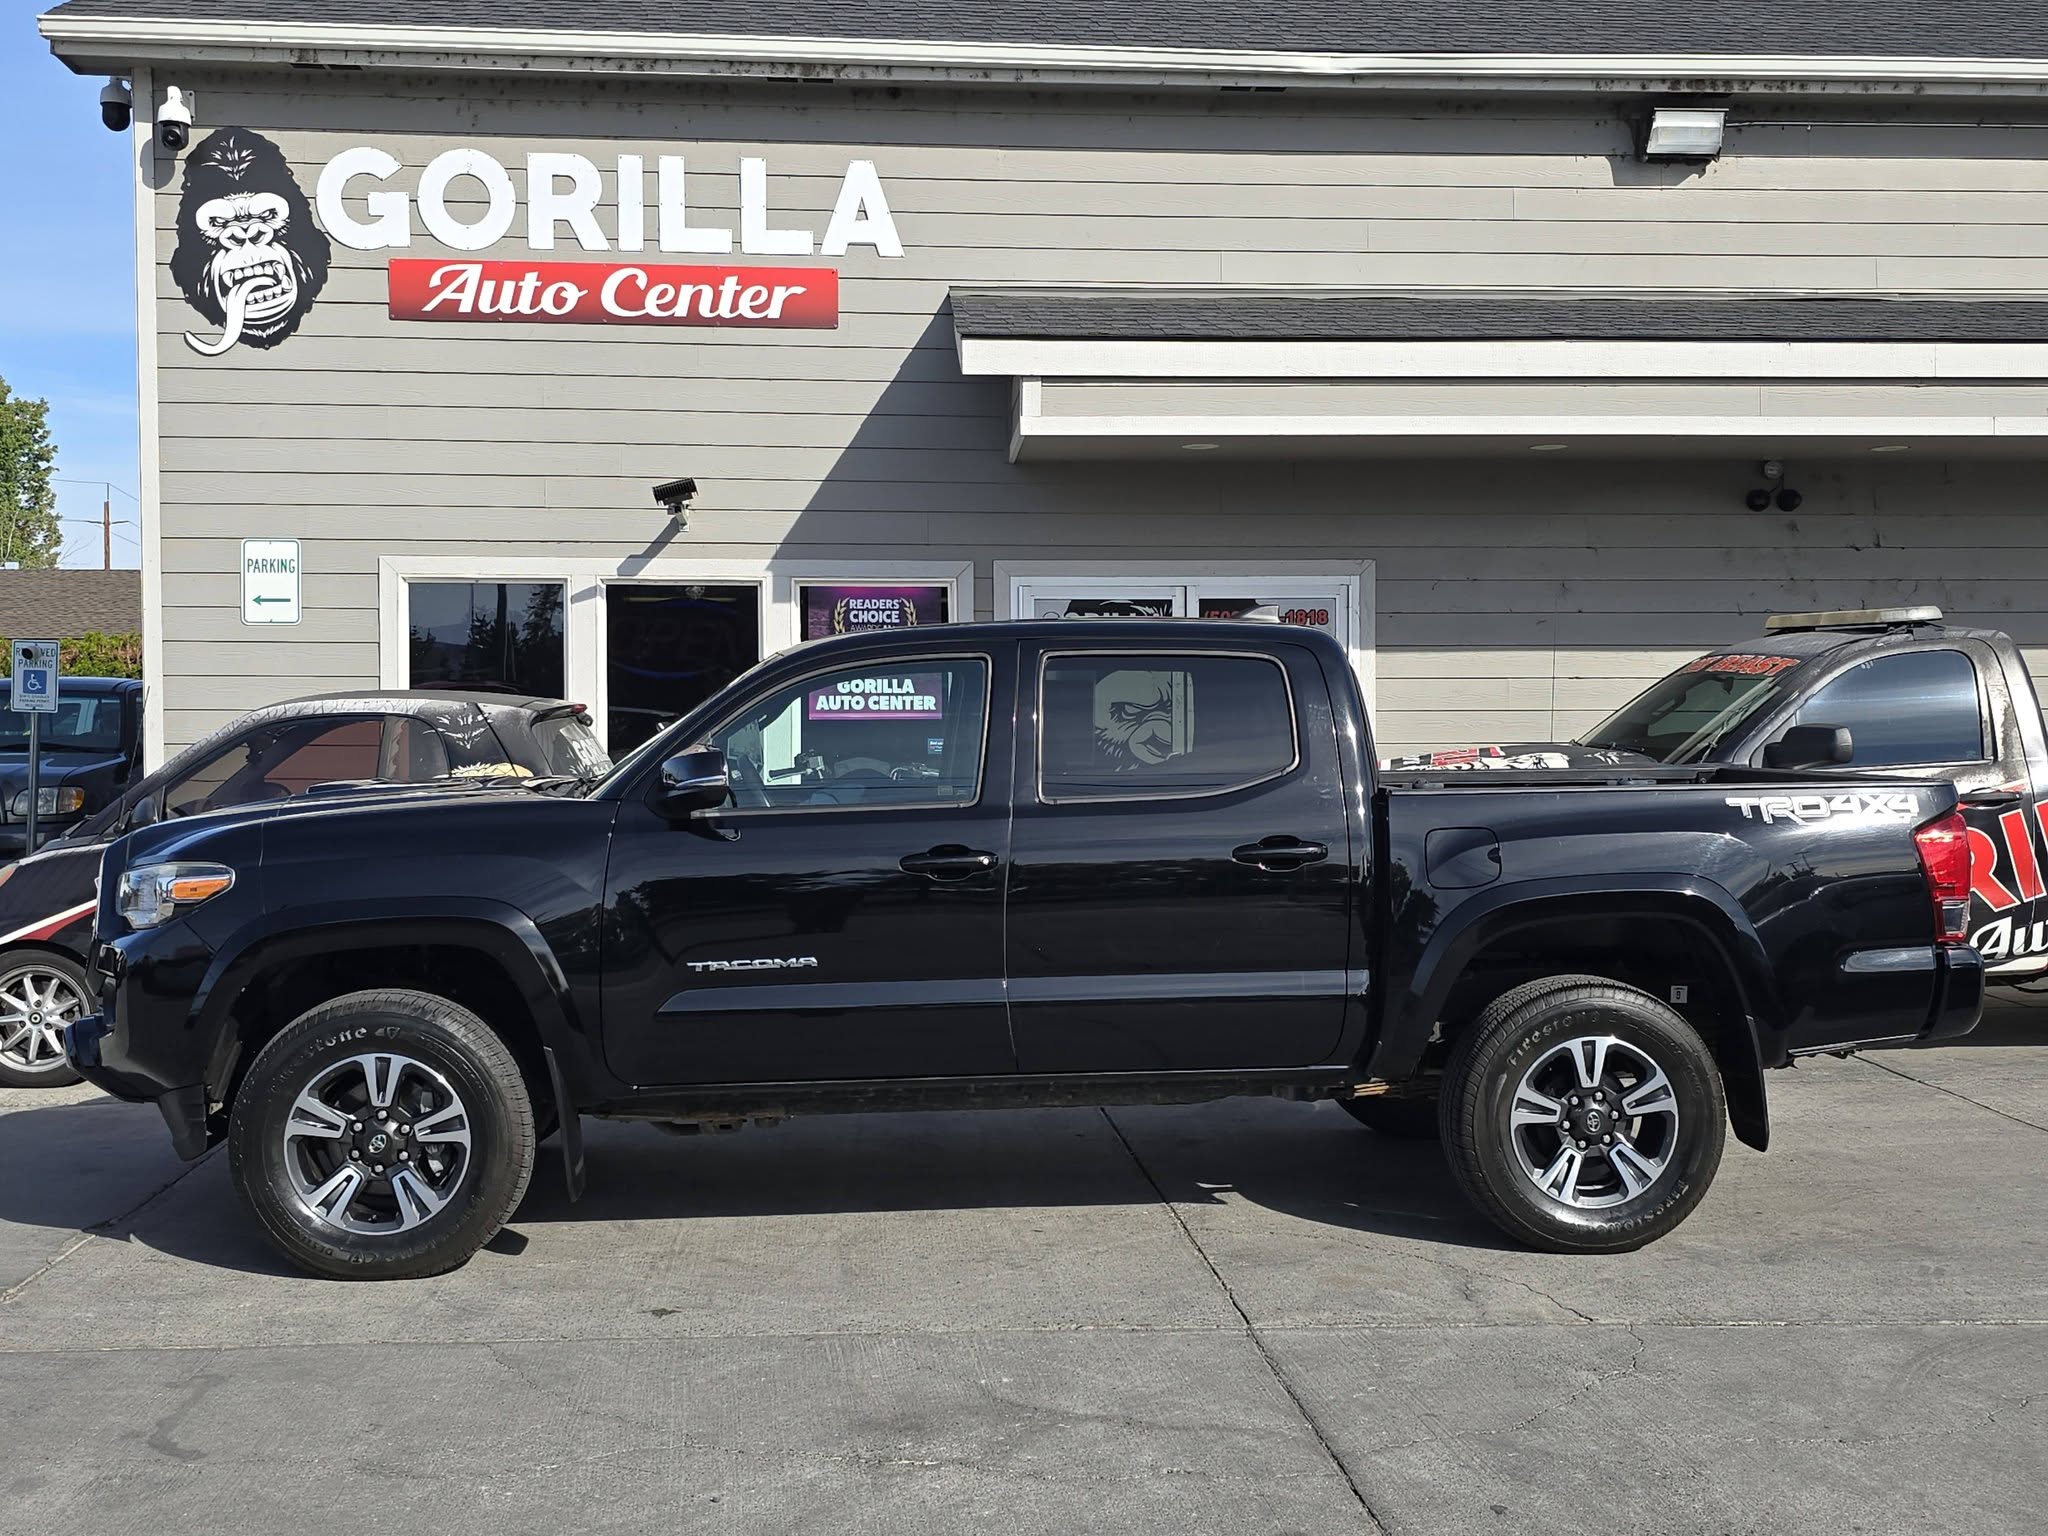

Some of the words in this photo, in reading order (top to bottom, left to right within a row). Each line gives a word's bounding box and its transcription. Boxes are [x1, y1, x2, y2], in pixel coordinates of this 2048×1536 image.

[315, 146, 906, 258] GORILLA
[421, 263, 589, 317] Auto
[599, 267, 807, 320] Center
[246, 558, 296, 574] PARKING
[849, 610, 900, 623] CHOICE
[16, 647, 56, 658] RVED
[18, 659, 53, 669] PARKING
[836, 678, 915, 694] GORILLA
[815, 695, 866, 711] AUTO
[867, 695, 937, 711] CENTER
[686, 956, 818, 972] TACOMA
